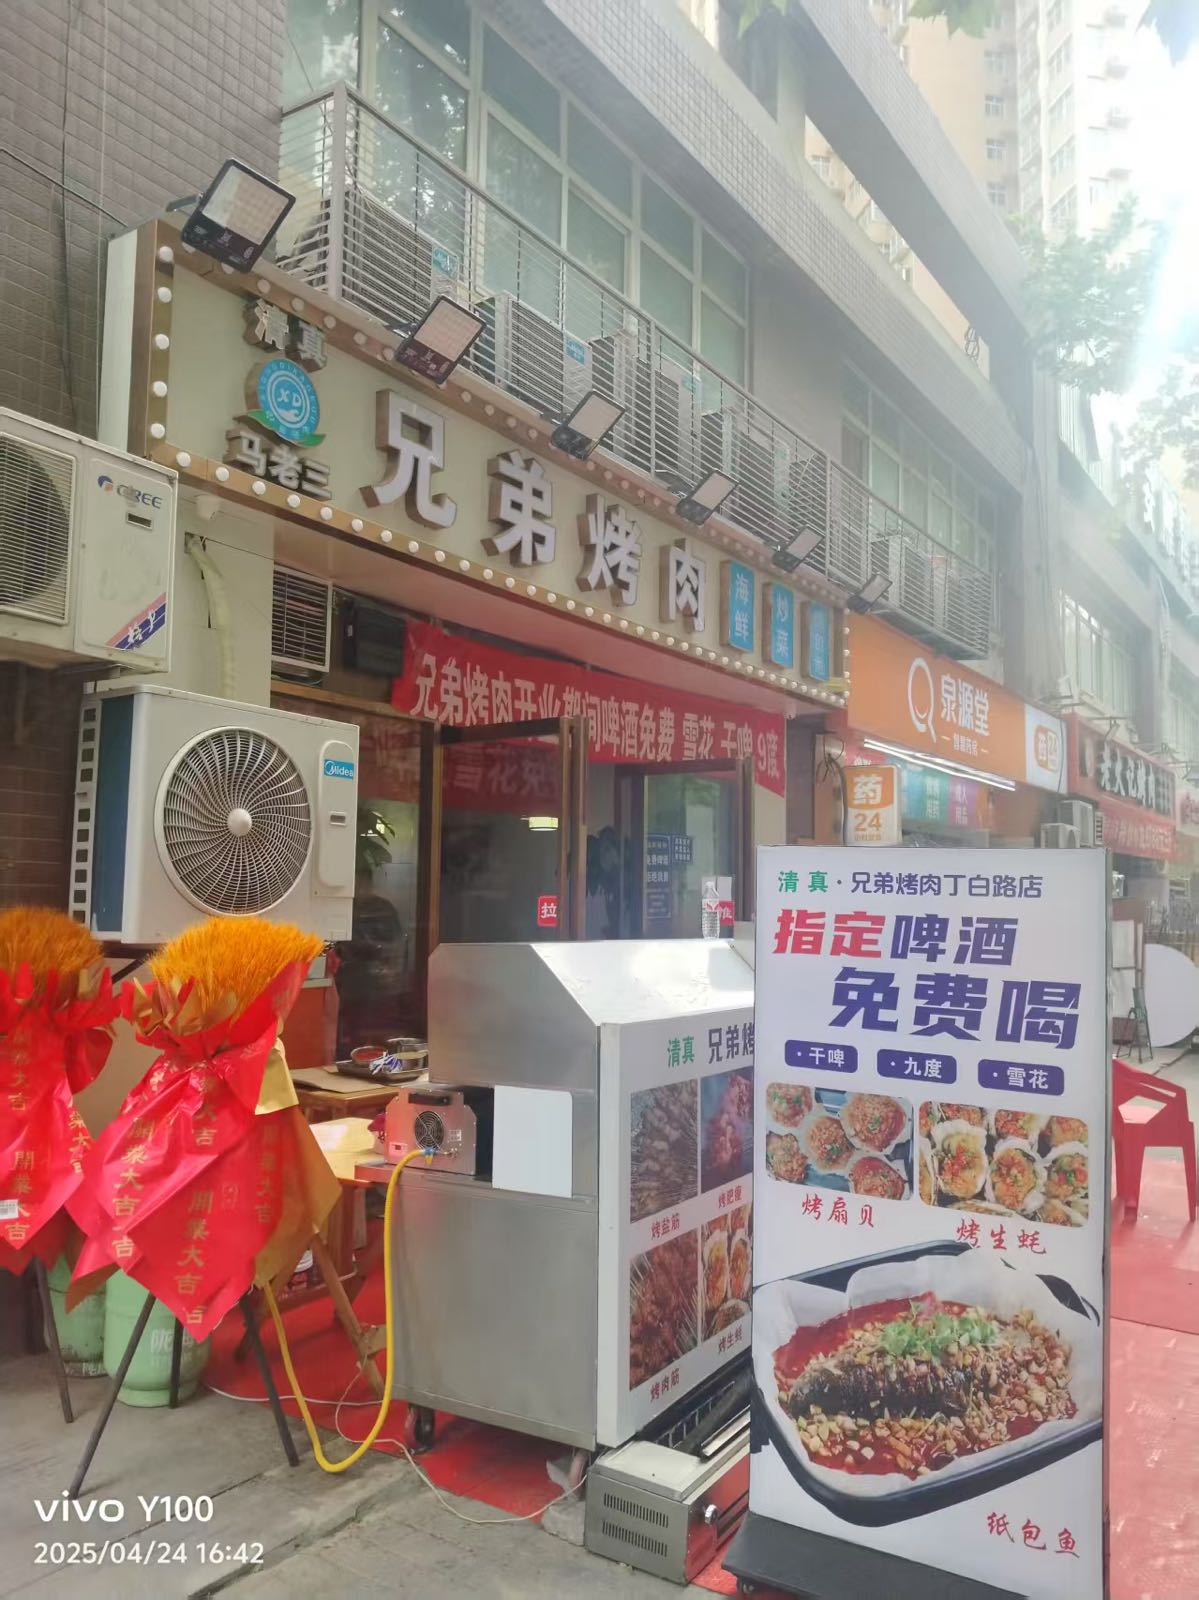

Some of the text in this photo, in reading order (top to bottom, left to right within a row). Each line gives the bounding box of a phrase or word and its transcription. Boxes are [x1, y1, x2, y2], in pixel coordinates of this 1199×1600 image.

[254, 299, 327, 369] 清真
[236, 430, 332, 500] 马老三
[116, 484, 163, 510] GREE
[360, 390, 706, 633] 兄弟烤肉
[734, 573, 750, 641] 海鲜
[776, 593, 789, 658] 炒菜
[940, 674, 990, 737] 泉源堂
[325, 761, 353, 777] Midea
[853, 774, 882, 805] 药
[854, 813, 882, 832] 24
[541, 903, 557, 919] 拉
[772, 908, 1019, 966] 指定啤酒
[828, 966, 1082, 1050] 免费喝
[667, 1035, 695, 1068] 清真
[802, 1193, 875, 1228] 烤扇贝
[956, 1218, 1047, 1255] 烤生蚝
[650, 1323, 743, 1401] 烤肉筋 烤生蚝
[986, 1511, 1081, 1559] 纸包鱼
